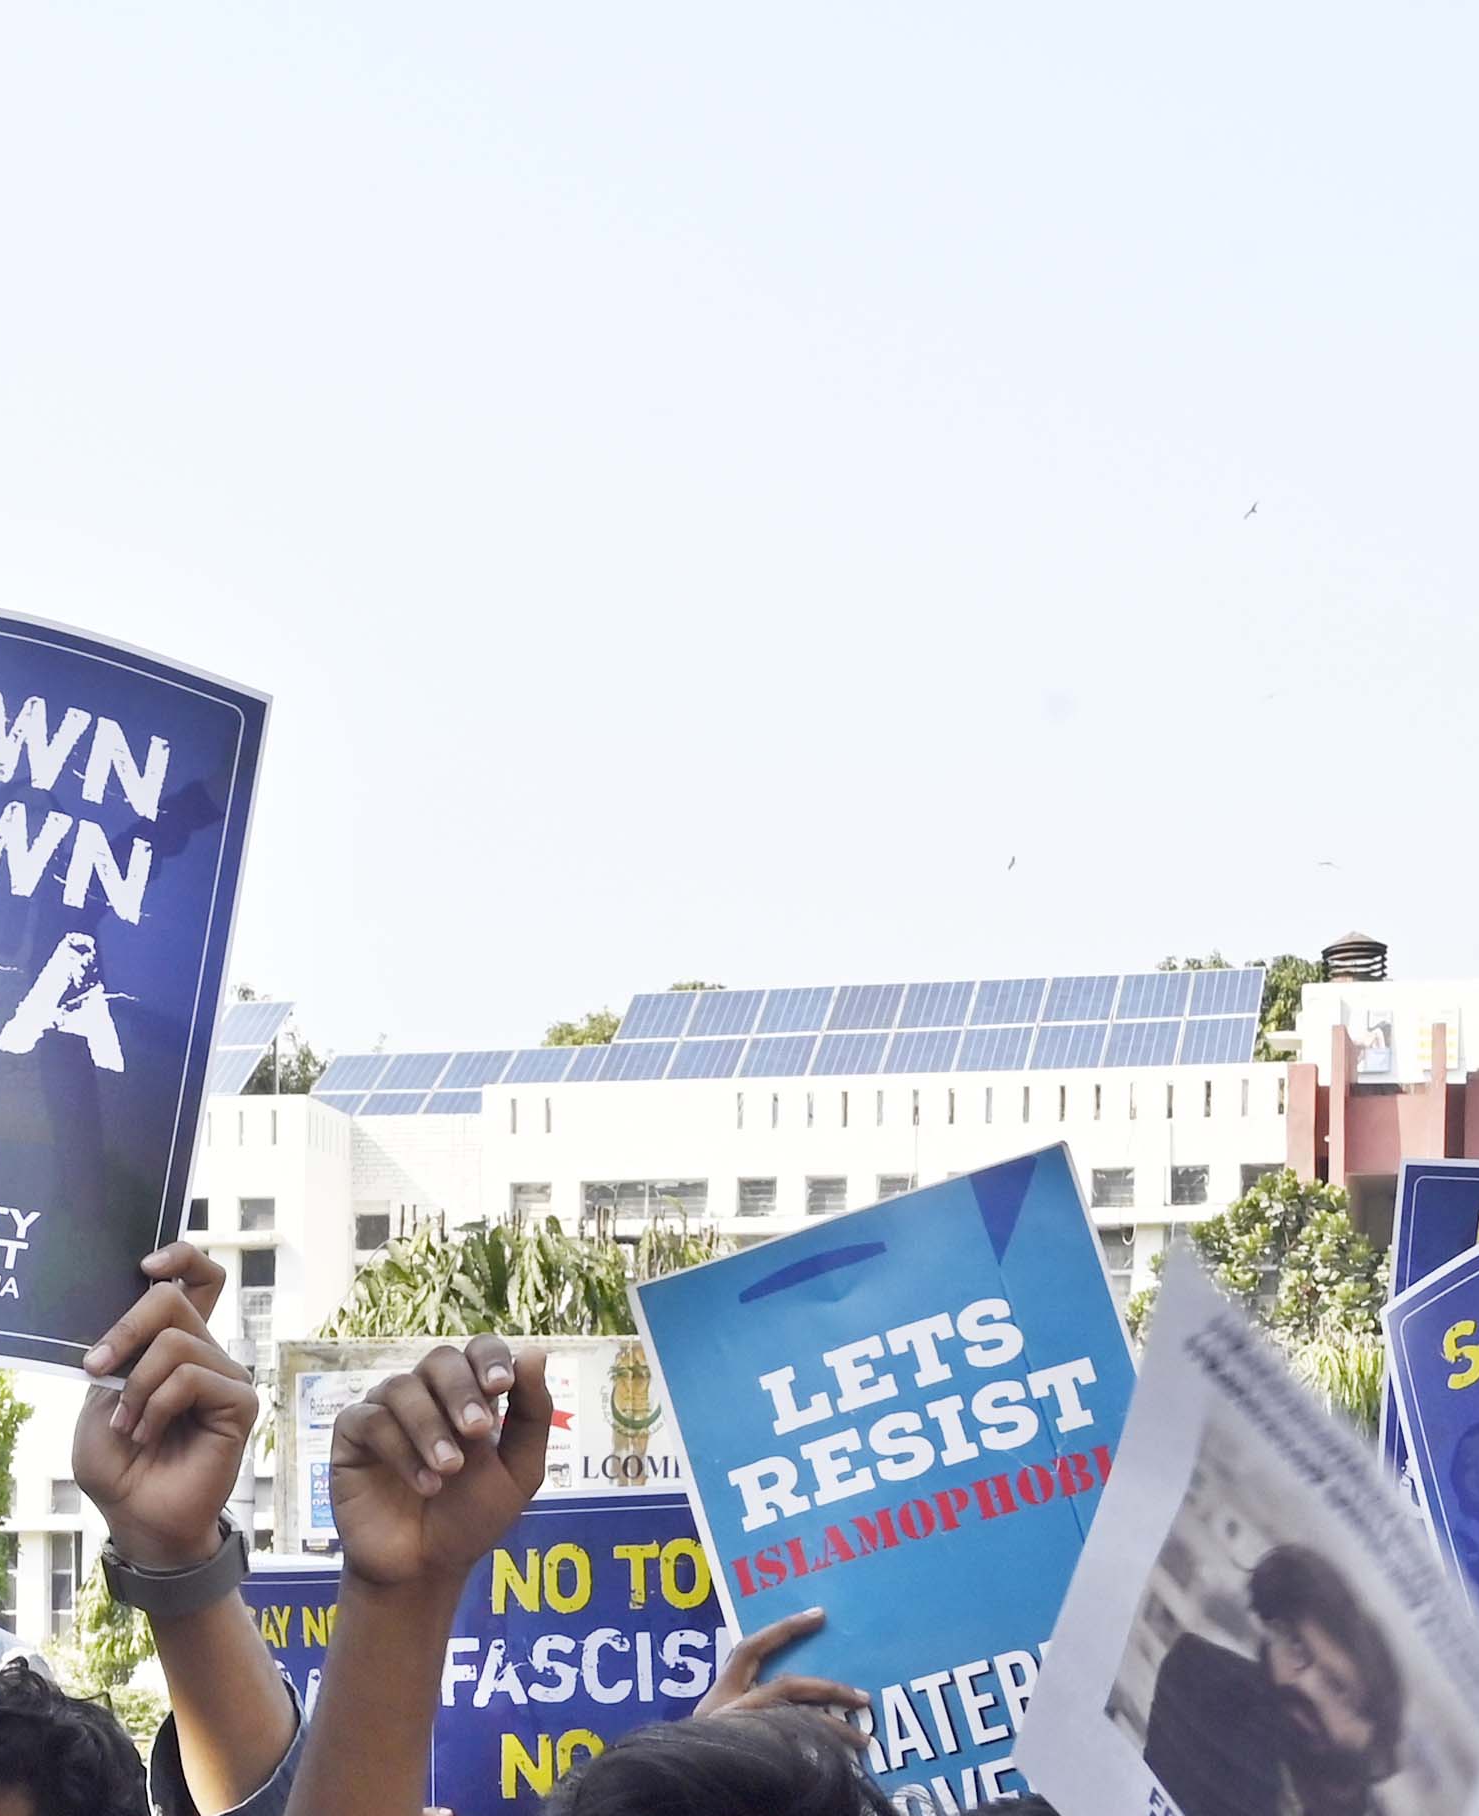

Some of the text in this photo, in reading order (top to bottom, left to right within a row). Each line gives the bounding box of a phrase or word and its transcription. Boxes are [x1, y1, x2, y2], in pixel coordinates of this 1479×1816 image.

[759, 1298, 1023, 1436] LETS
[728, 1356, 1097, 1532] RESIST
[491, 1537, 712, 1614] NO TO
[441, 1627, 738, 1708] FASCIS
